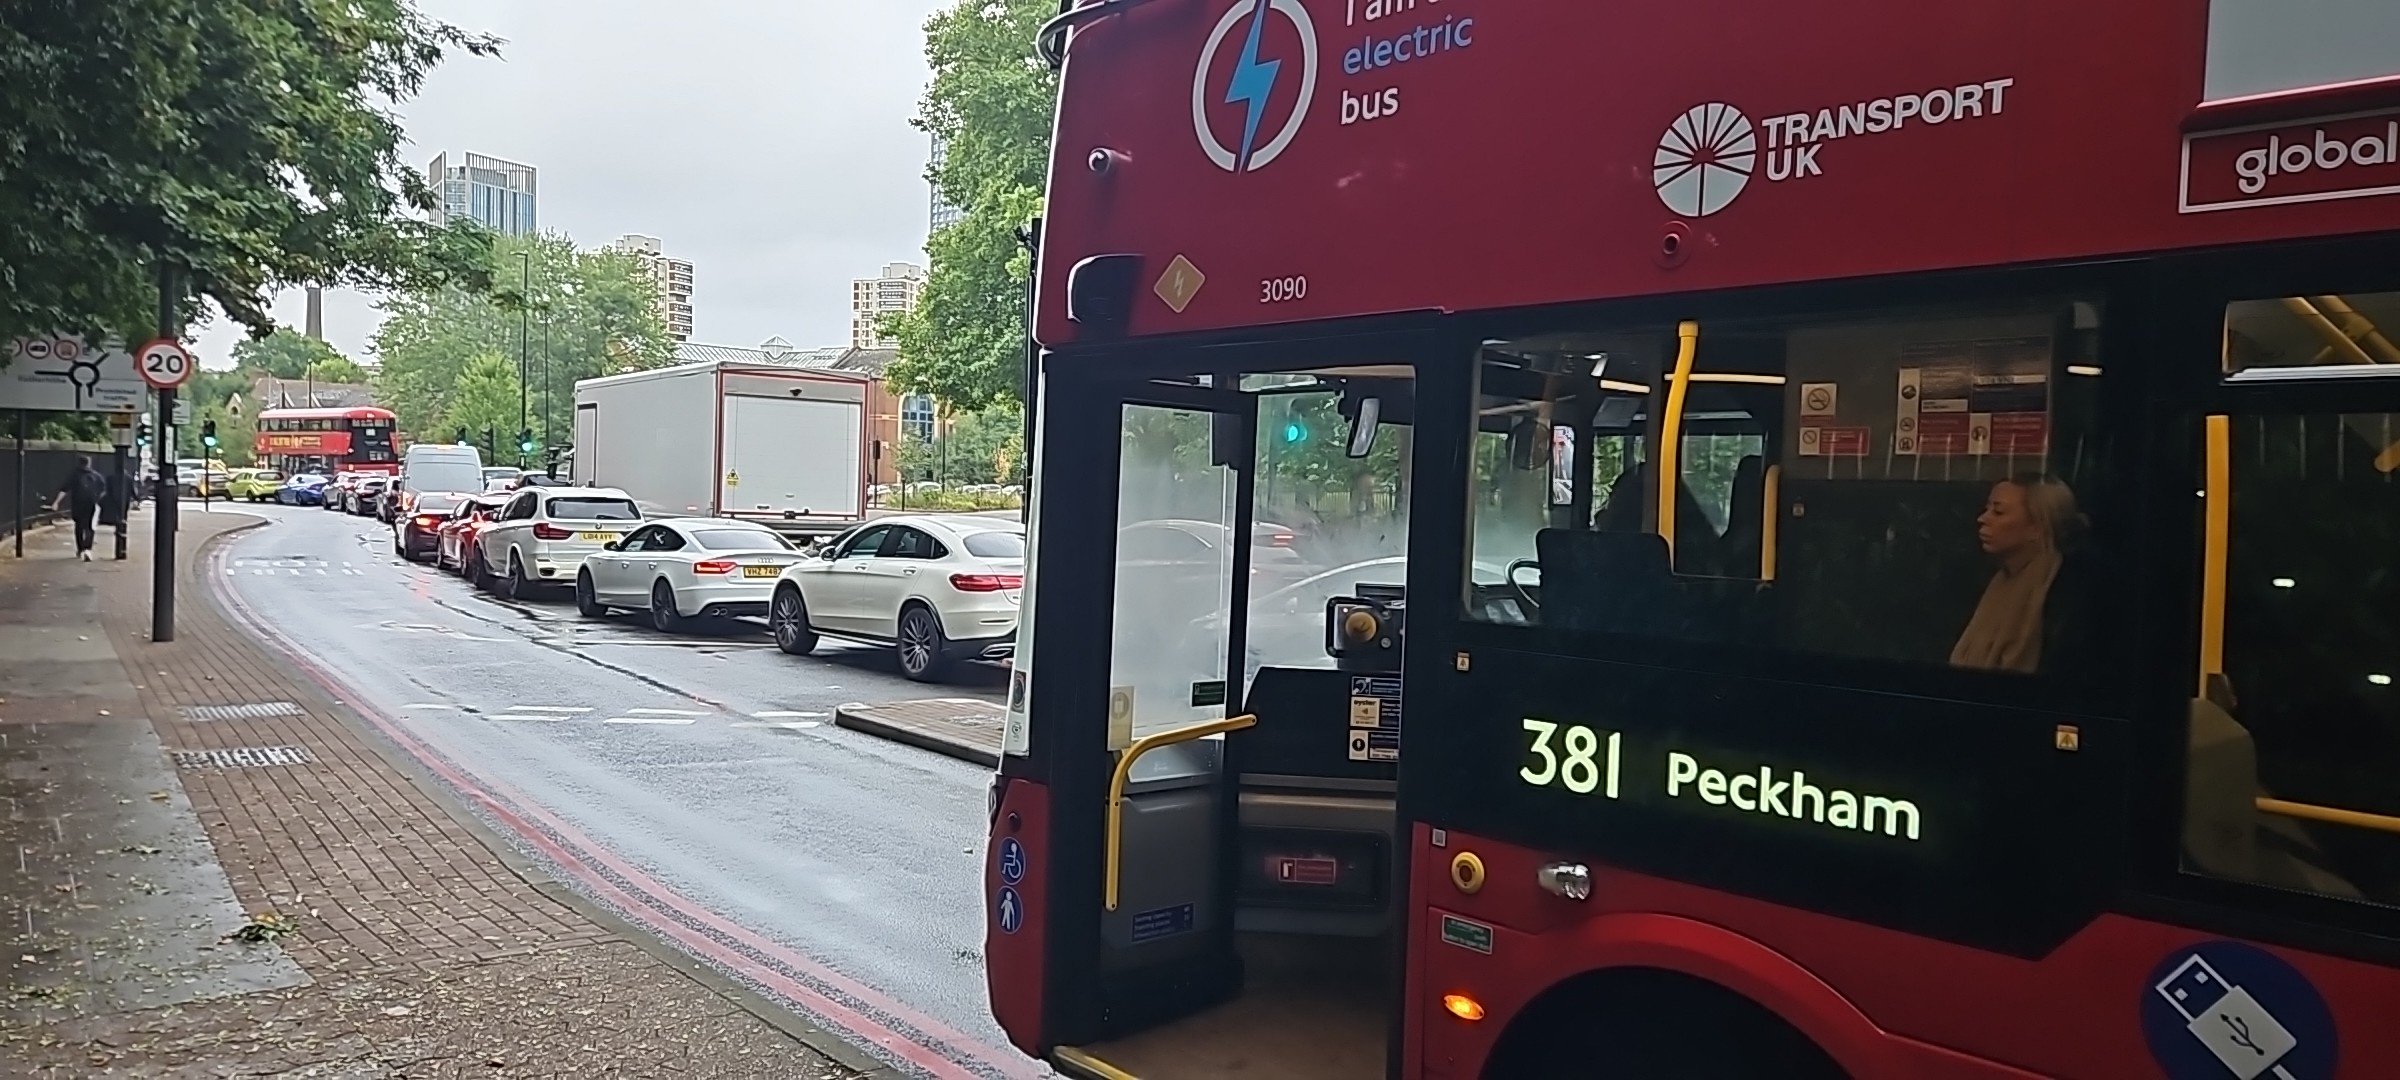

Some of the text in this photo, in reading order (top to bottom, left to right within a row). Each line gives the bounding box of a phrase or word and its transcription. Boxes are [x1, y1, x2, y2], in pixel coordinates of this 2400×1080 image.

[1343, 14, 1473, 75] electric
[1340, 87, 1399, 125] bus
[1761, 77, 2014, 149] TRANSPORT
[1766, 143, 1823, 182] UK
[2235, 120, 2399, 194] global
[1260, 275, 1307, 303] 3090
[146, 353, 184, 374] 20
[1519, 718, 1921, 841] 381 Peckham
